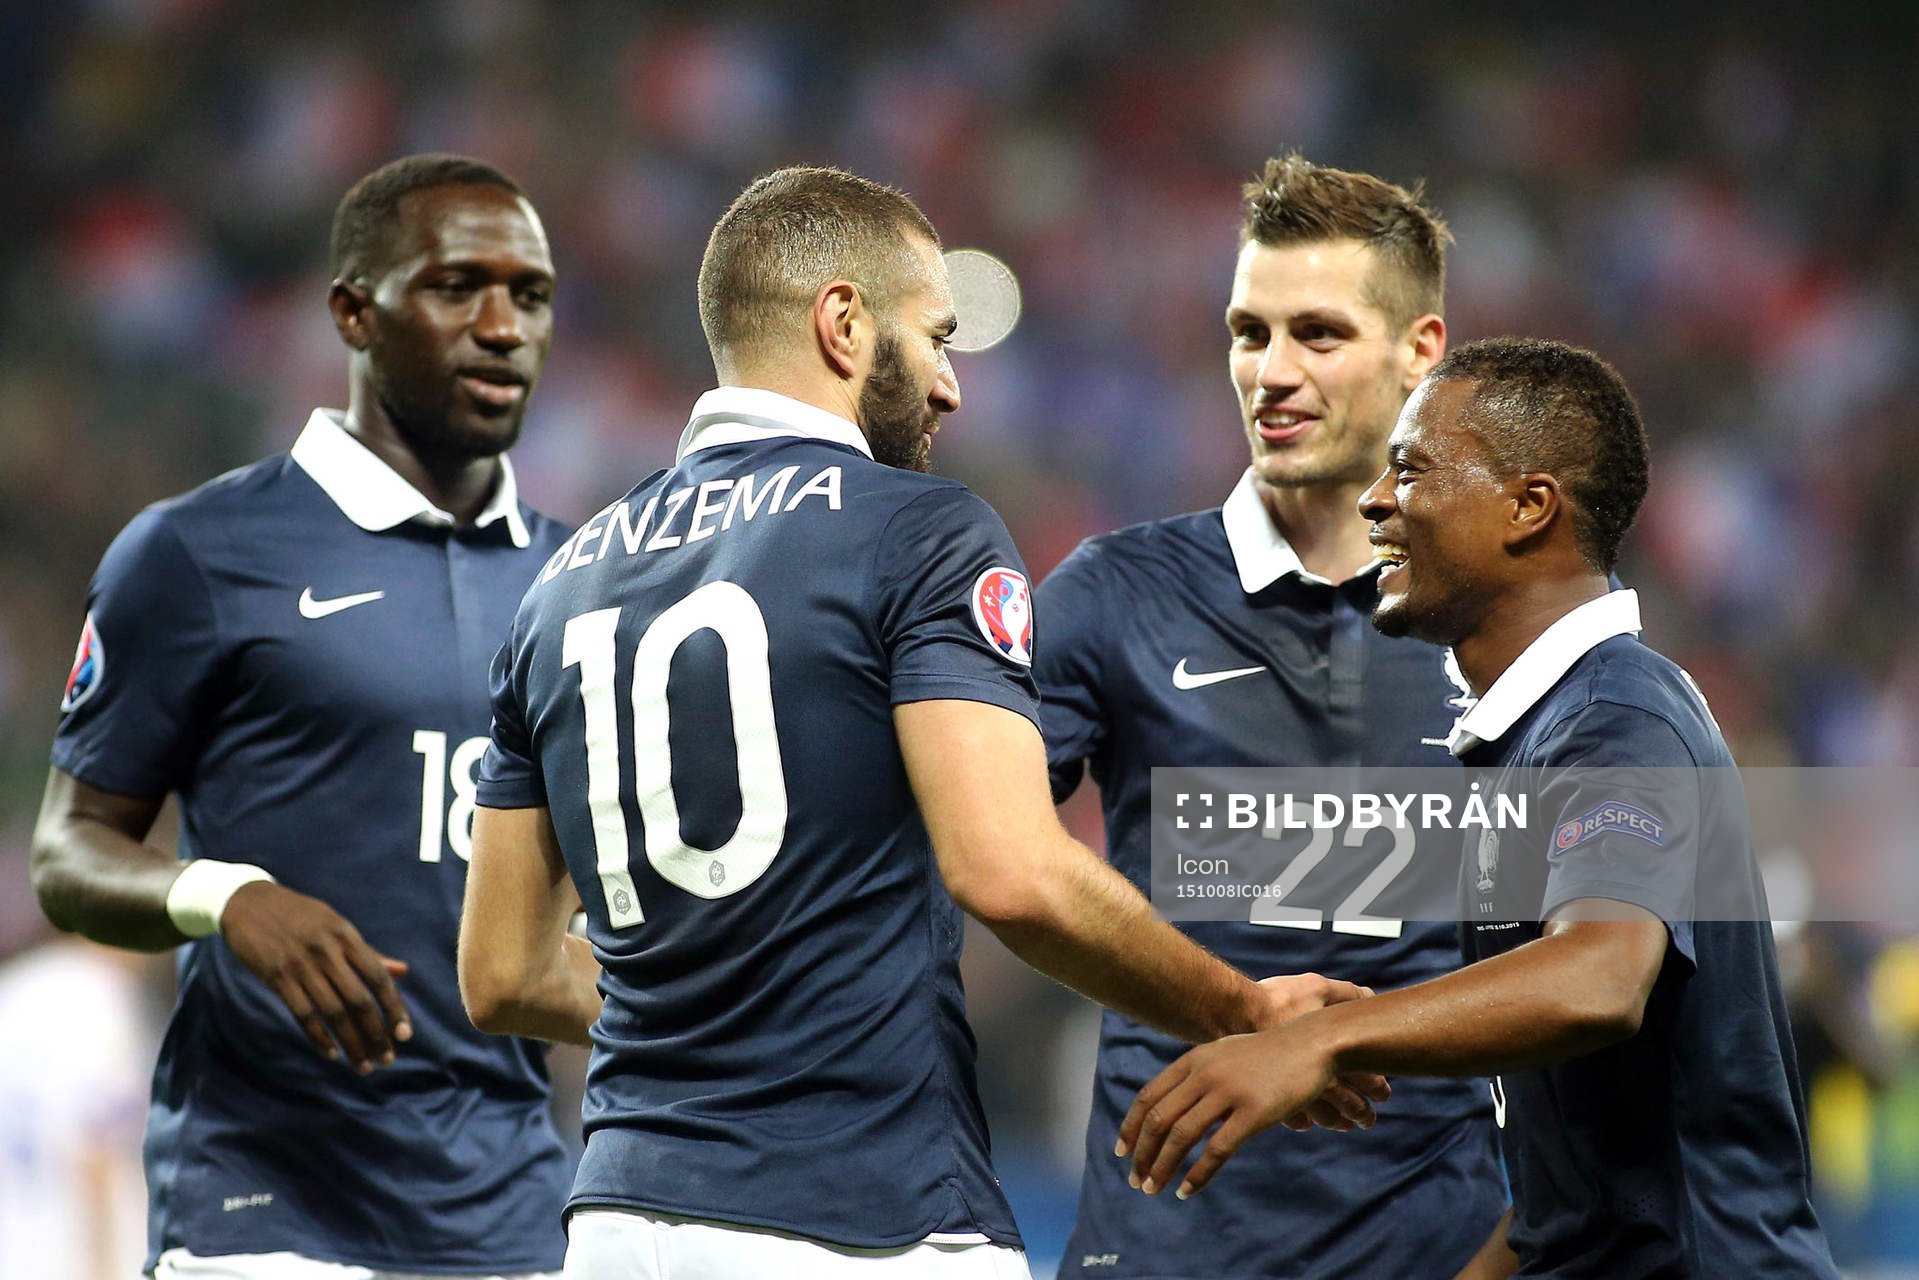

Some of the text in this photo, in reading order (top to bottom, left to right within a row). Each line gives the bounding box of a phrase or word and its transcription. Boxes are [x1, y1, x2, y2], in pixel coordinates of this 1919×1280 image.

[540, 465, 842, 586] BENZEMA
[561, 580, 789, 931] 10
[1248, 801, 1417, 939] 22
[1583, 808, 1663, 839] RESPECT
